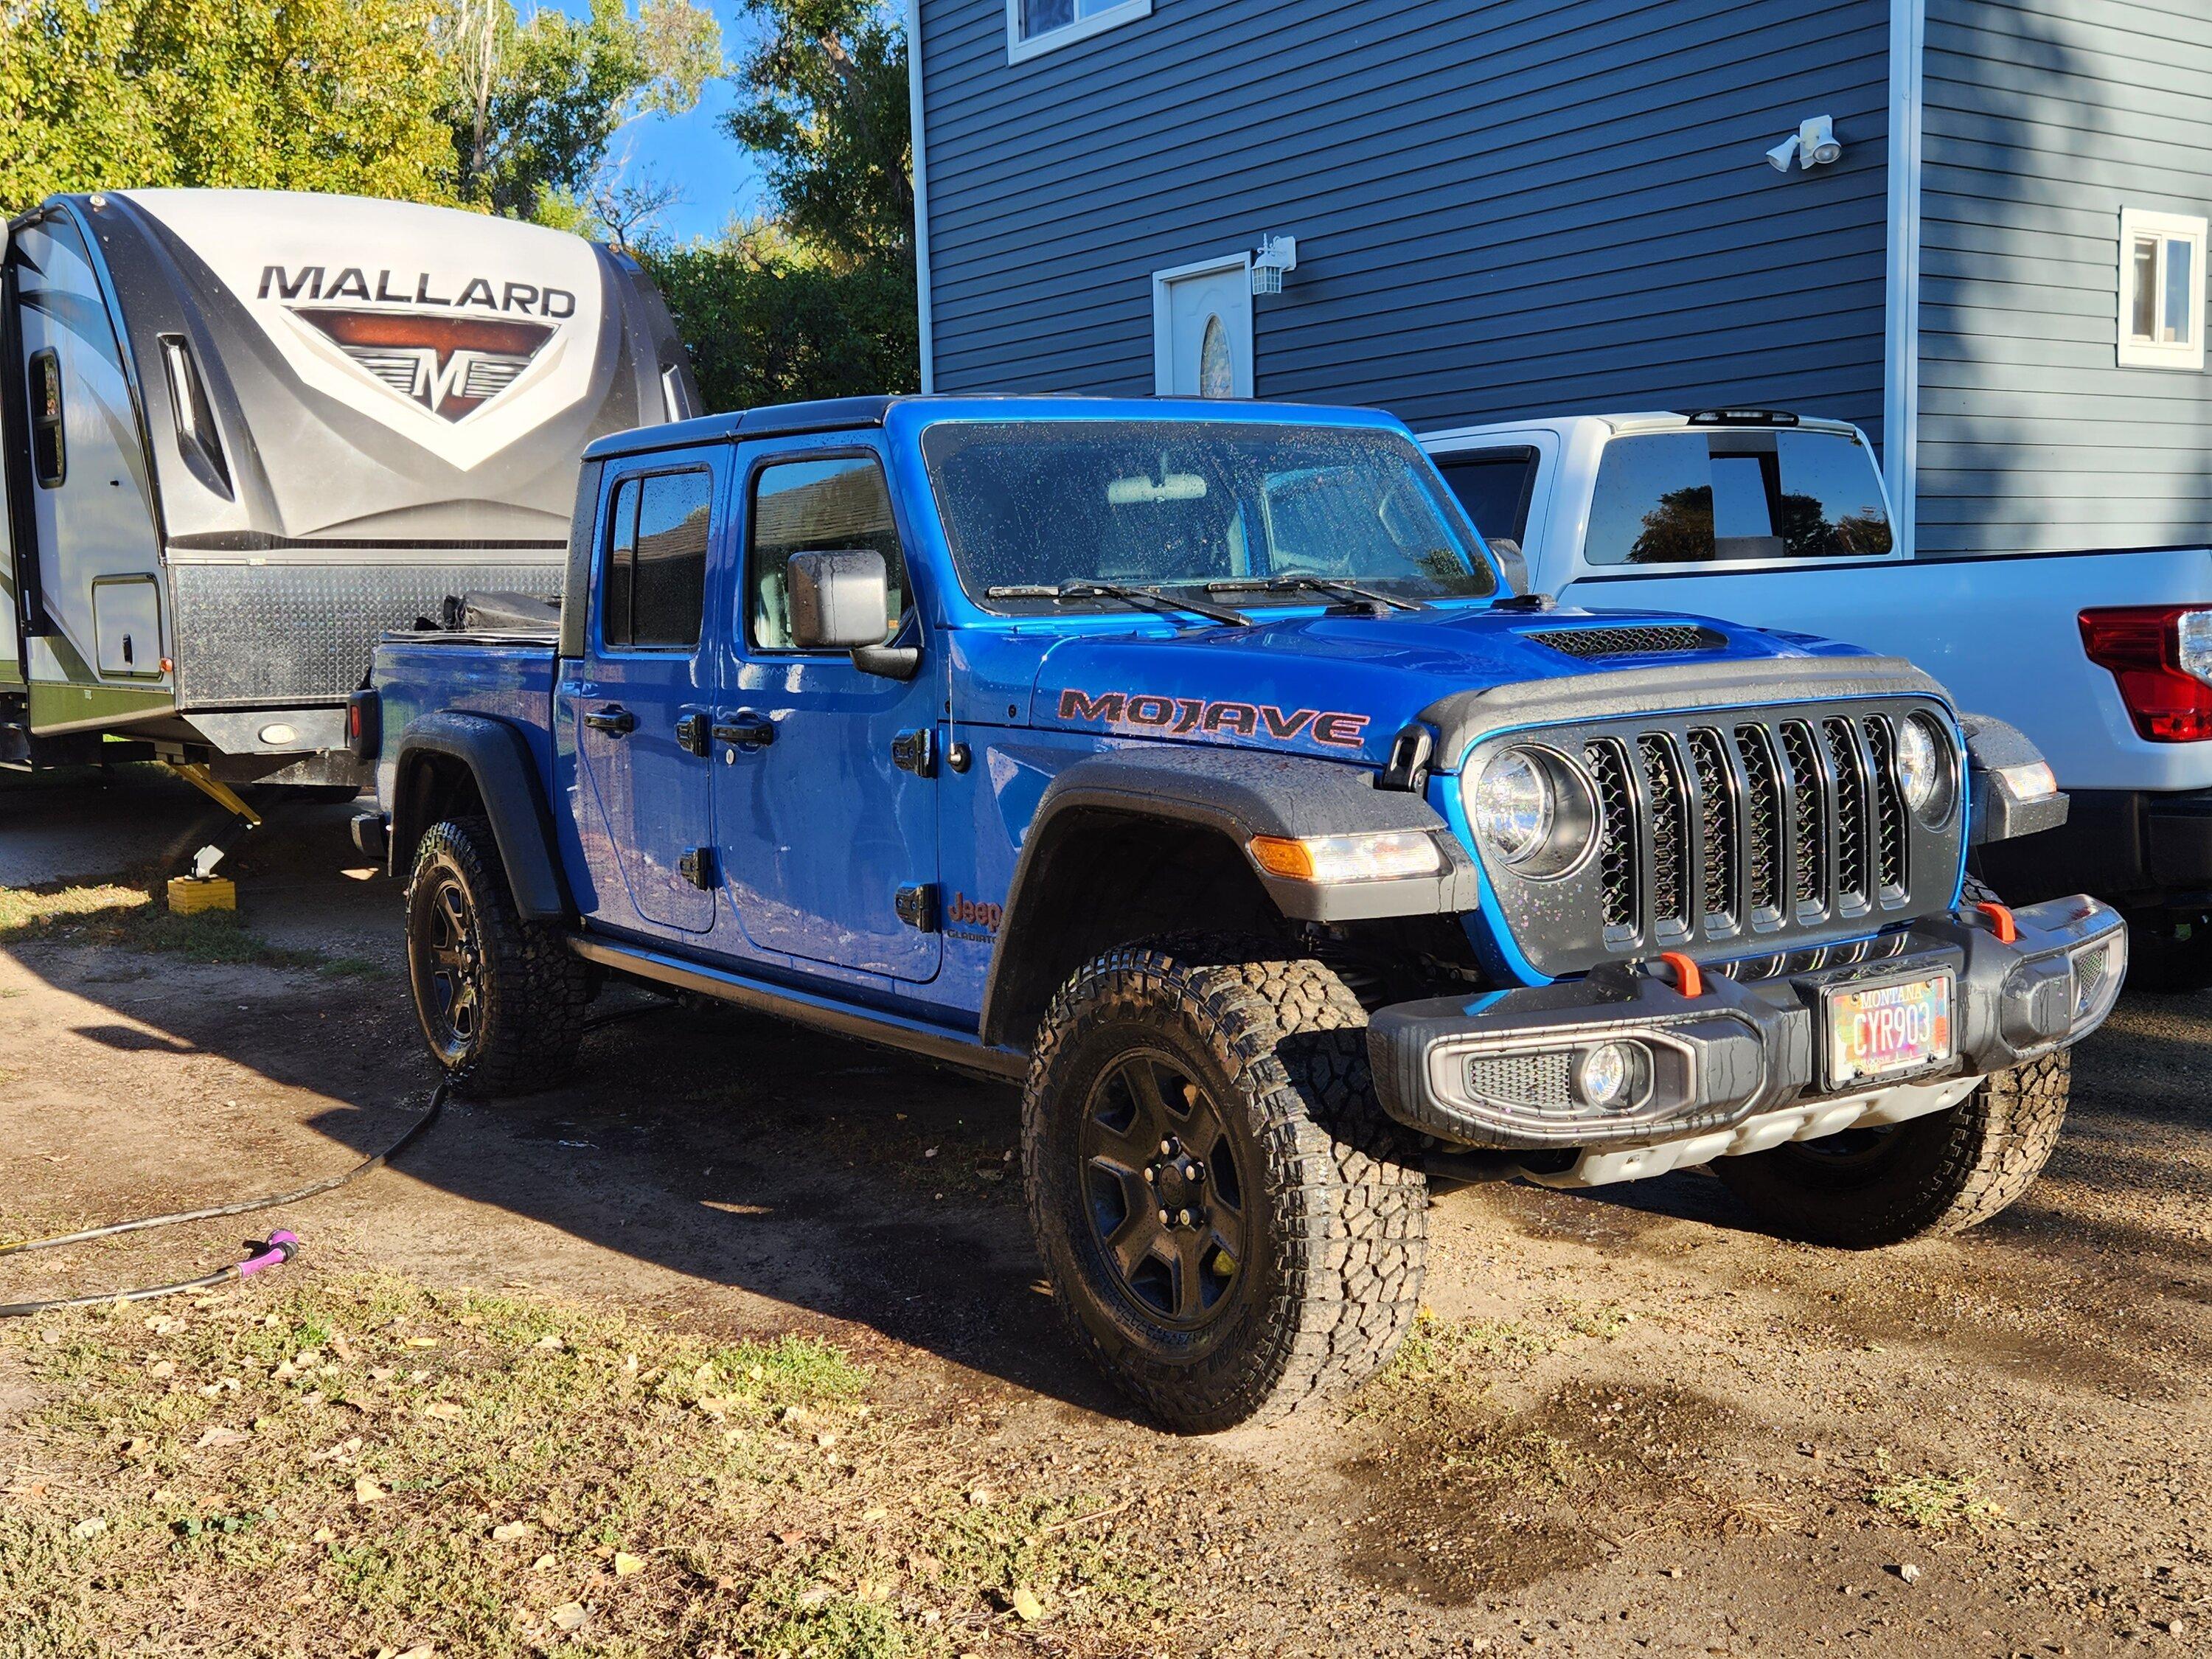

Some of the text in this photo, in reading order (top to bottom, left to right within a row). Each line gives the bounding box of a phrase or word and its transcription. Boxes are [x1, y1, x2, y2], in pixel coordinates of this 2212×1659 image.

[257, 266, 576, 319] MALLARD
[411, 349, 470, 413] M
[1058, 688, 1371, 748] MOJAVE
[947, 891, 1003, 933] Jeep
[1860, 982, 1924, 1009] MONTANA
[1853, 1001, 1930, 1056] CYR903
